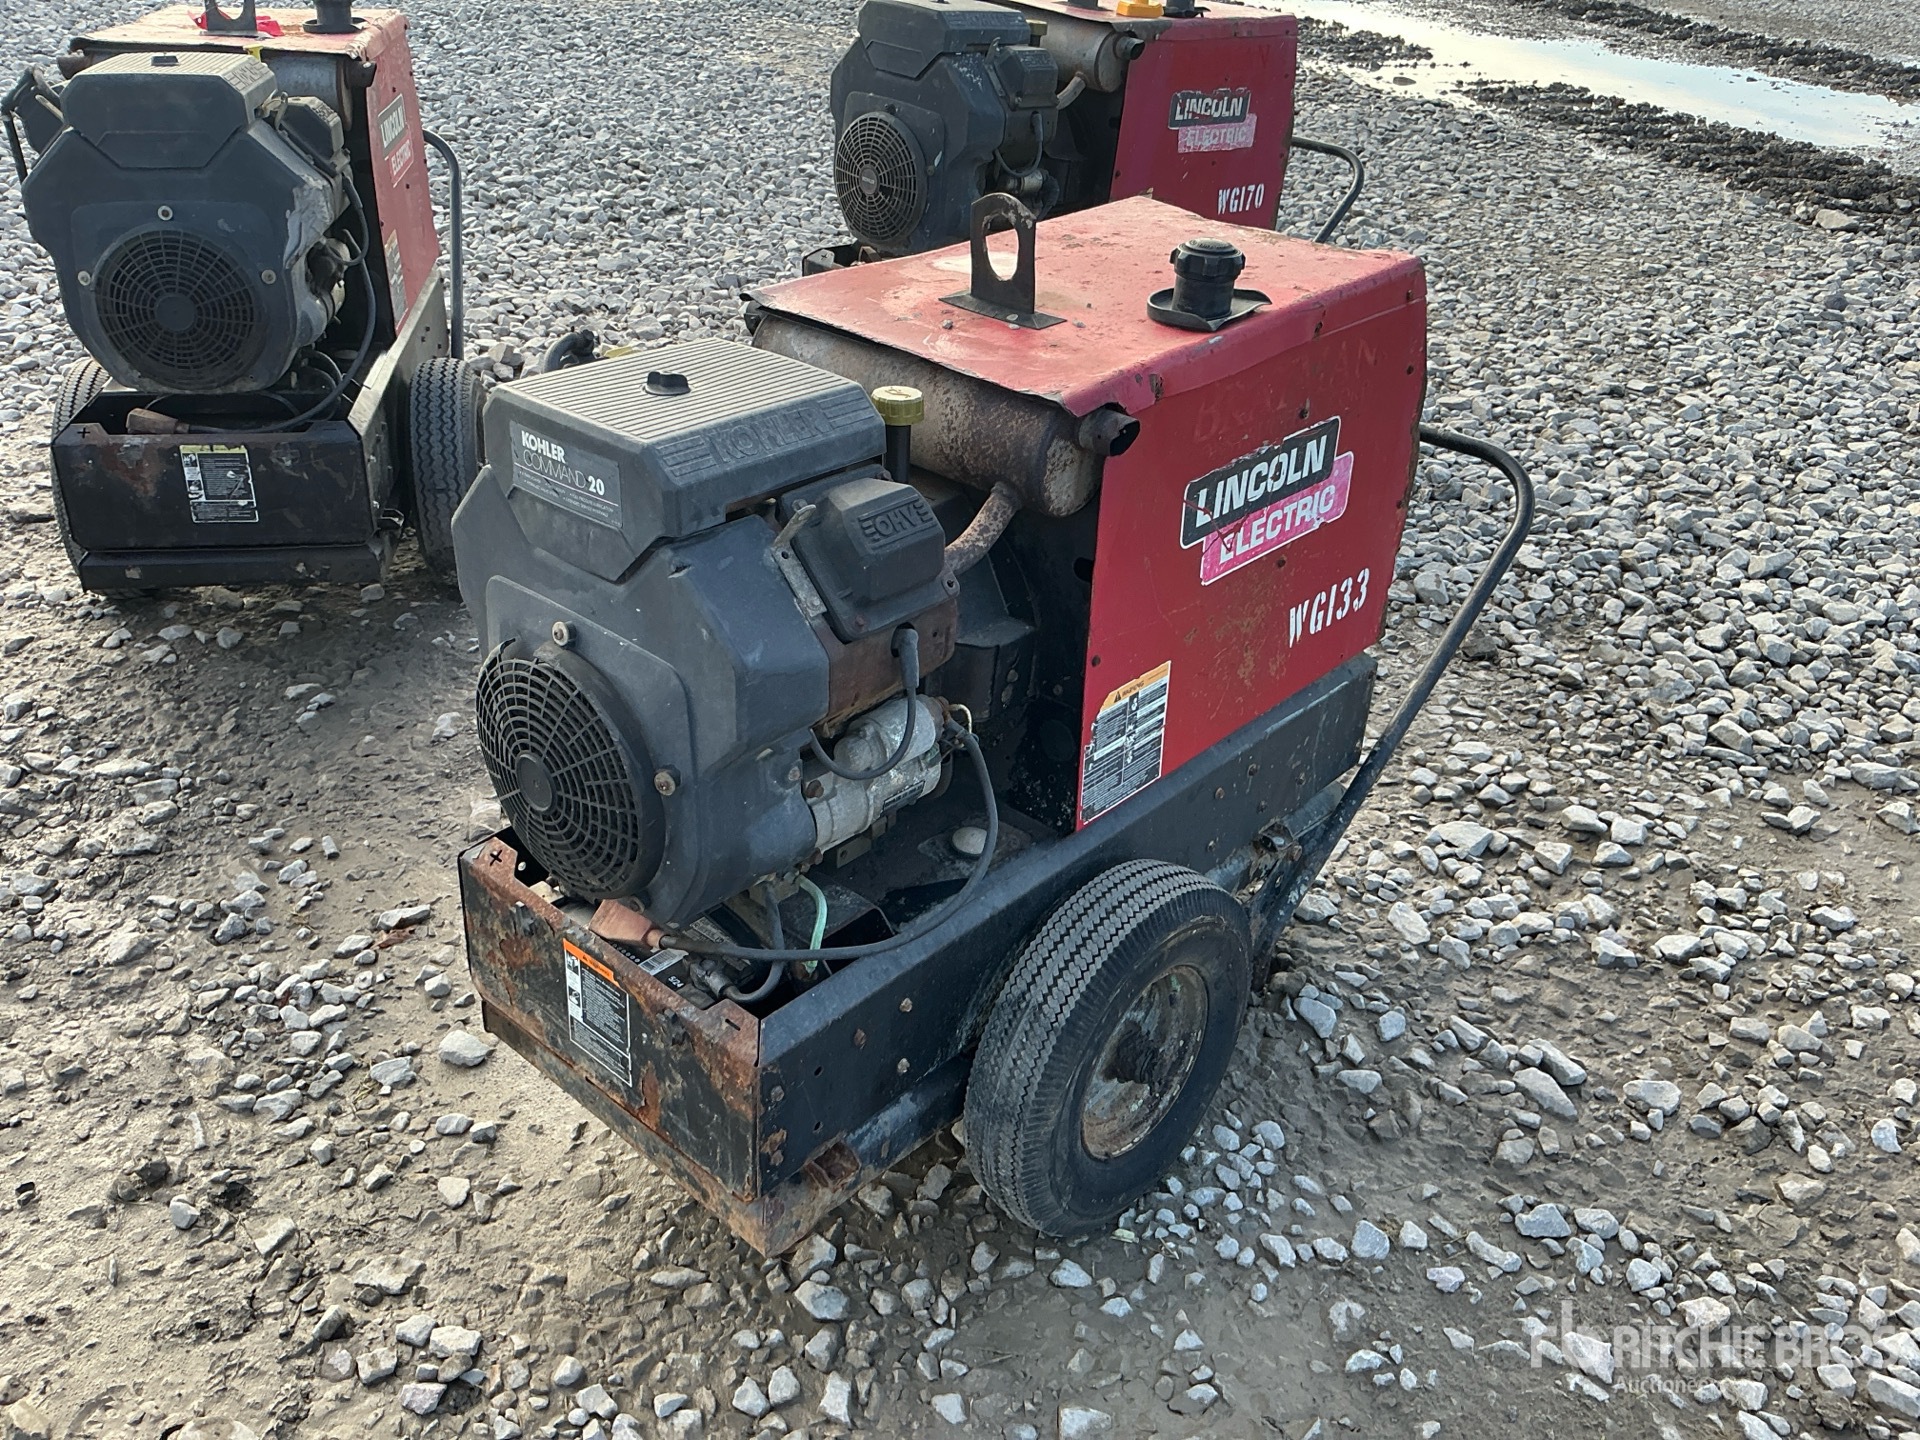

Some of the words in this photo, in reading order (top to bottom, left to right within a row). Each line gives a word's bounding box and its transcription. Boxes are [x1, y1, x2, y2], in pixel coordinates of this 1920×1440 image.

[1175, 97, 1243, 121] LINCOLN
[1186, 128, 1248, 147] ELECTRIC
[1217, 183, 1265, 215] WG170
[521, 430, 566, 464] KOHLER
[708, 406, 835, 463] KOHLER
[523, 449, 586, 489] COMMAND
[587, 475, 605, 496] 20
[1195, 435, 1328, 528] LINCOLN
[1219, 484, 1336, 565] ELECTRIC
[1289, 567, 1370, 648] WG133
